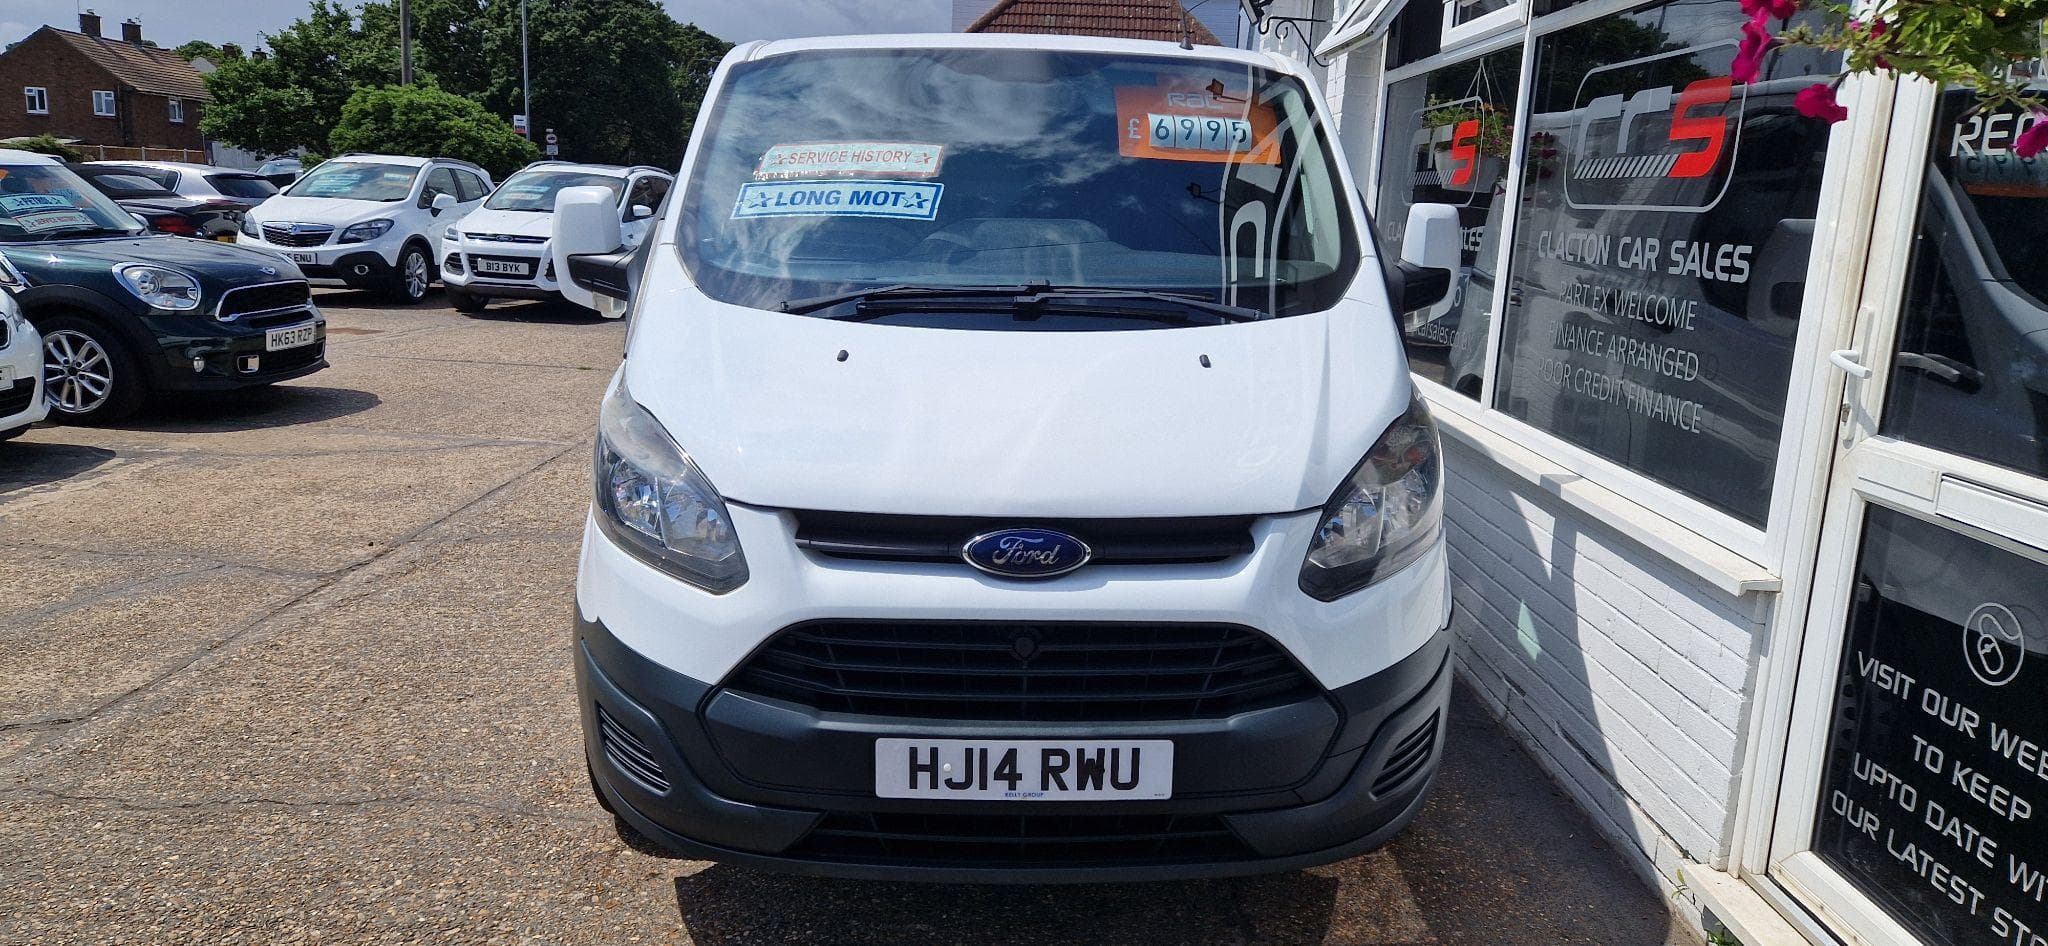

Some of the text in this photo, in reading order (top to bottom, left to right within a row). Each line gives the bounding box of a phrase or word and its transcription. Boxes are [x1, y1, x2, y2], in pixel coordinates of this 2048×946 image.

[1128, 118, 1247, 143] £ 6995
[788, 149, 912, 165] SERVICE HISTORY
[774, 190, 905, 206] LONG MOT
[294, 253, 312, 263] ENU
[486, 262, 521, 272] B13 BYK
[1538, 231, 1753, 284] CLACTON CAR SALES
[1558, 281, 1698, 331] PART EX WELCOME
[271, 327, 313, 347] HK63 RZP
[1548, 319, 1699, 382] FINANCE ARRANGED
[1537, 357, 1703, 435] POOR CREDIT FINANCE
[992, 536, 1061, 565] Ford
[1857, 651, 1916, 701] VISIT
[1921, 688, 1980, 739] OUR
[908, 747, 1141, 791] HJ14 RWU
[1912, 735, 2032, 822] TO KEEP
[1853, 752, 2048, 902] UPTO DATE WI
[1832, 789, 1880, 842] OUR
[1886, 828, 1985, 915] LATEST
